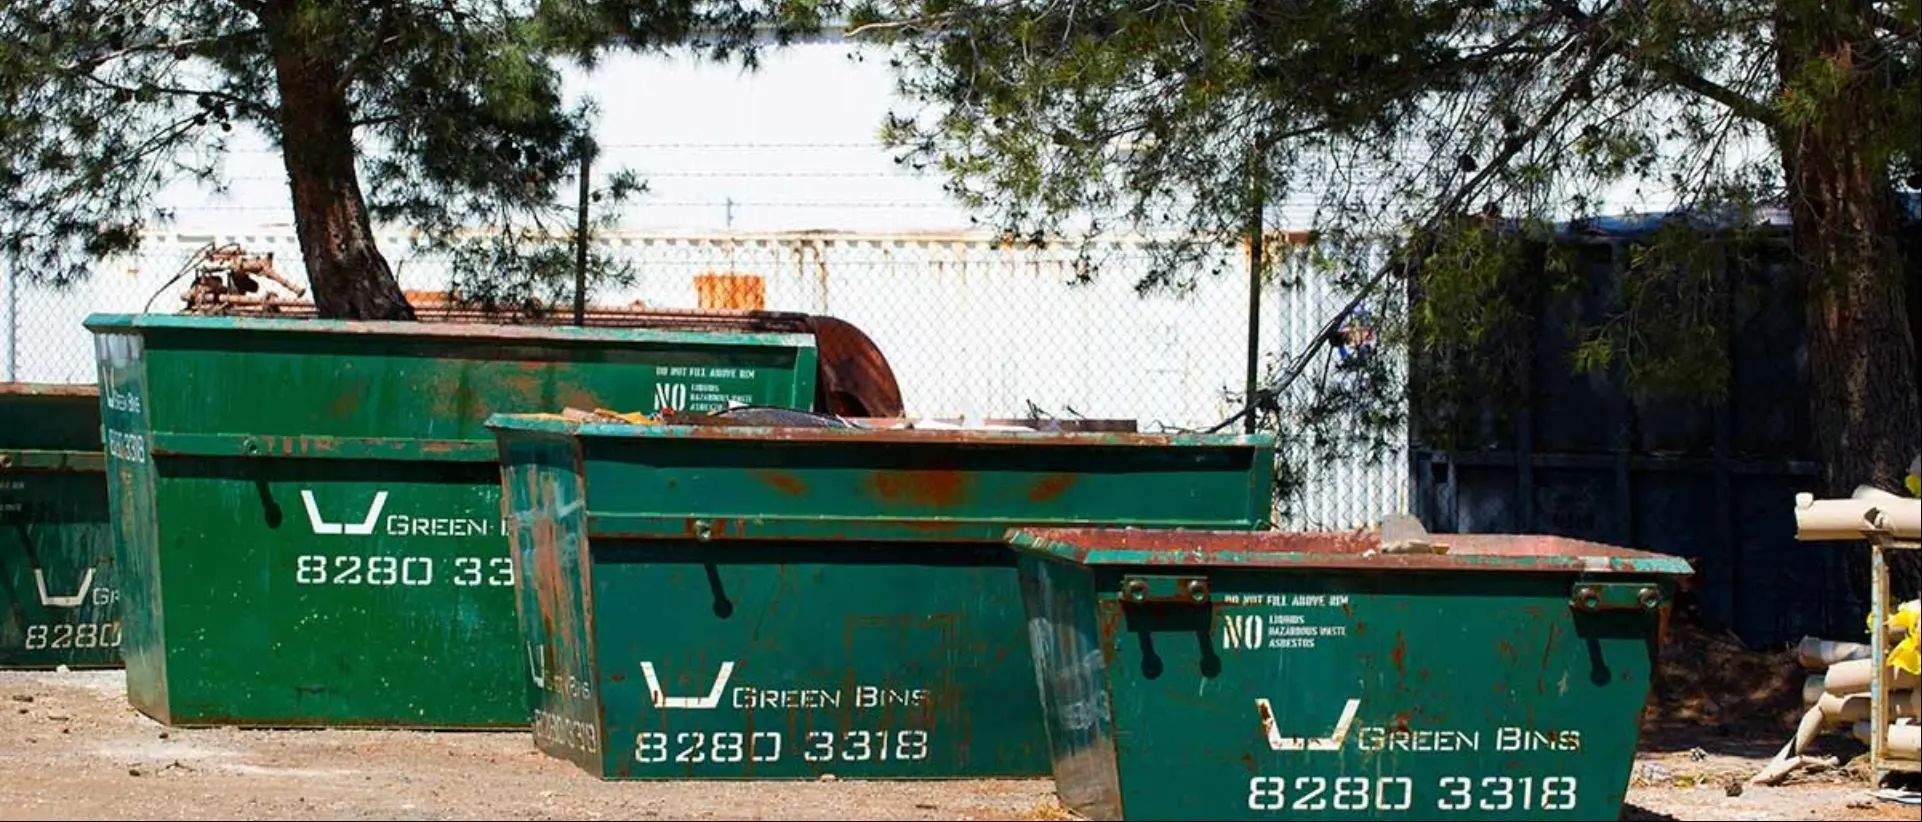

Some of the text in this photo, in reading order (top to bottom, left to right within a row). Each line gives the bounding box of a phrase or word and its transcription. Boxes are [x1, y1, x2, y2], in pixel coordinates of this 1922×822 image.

[654, 383, 687, 411] NO
[386, 514, 489, 537] GREEN
[296, 554, 434, 586] 8280
[1267, 595, 1288, 607] FILL
[1291, 595, 1326, 608] ABOVE
[1329, 595, 1349, 607] RIM
[25, 623, 123, 651] 8280
[1223, 614, 1264, 650] NO
[1268, 638, 1316, 649] ASBESTOS
[732, 686, 841, 709] GREEN
[635, 730, 929, 764] 8280 3318
[1358, 727, 1480, 752] GREEN
[1247, 776, 1578, 811] 8280 3318
